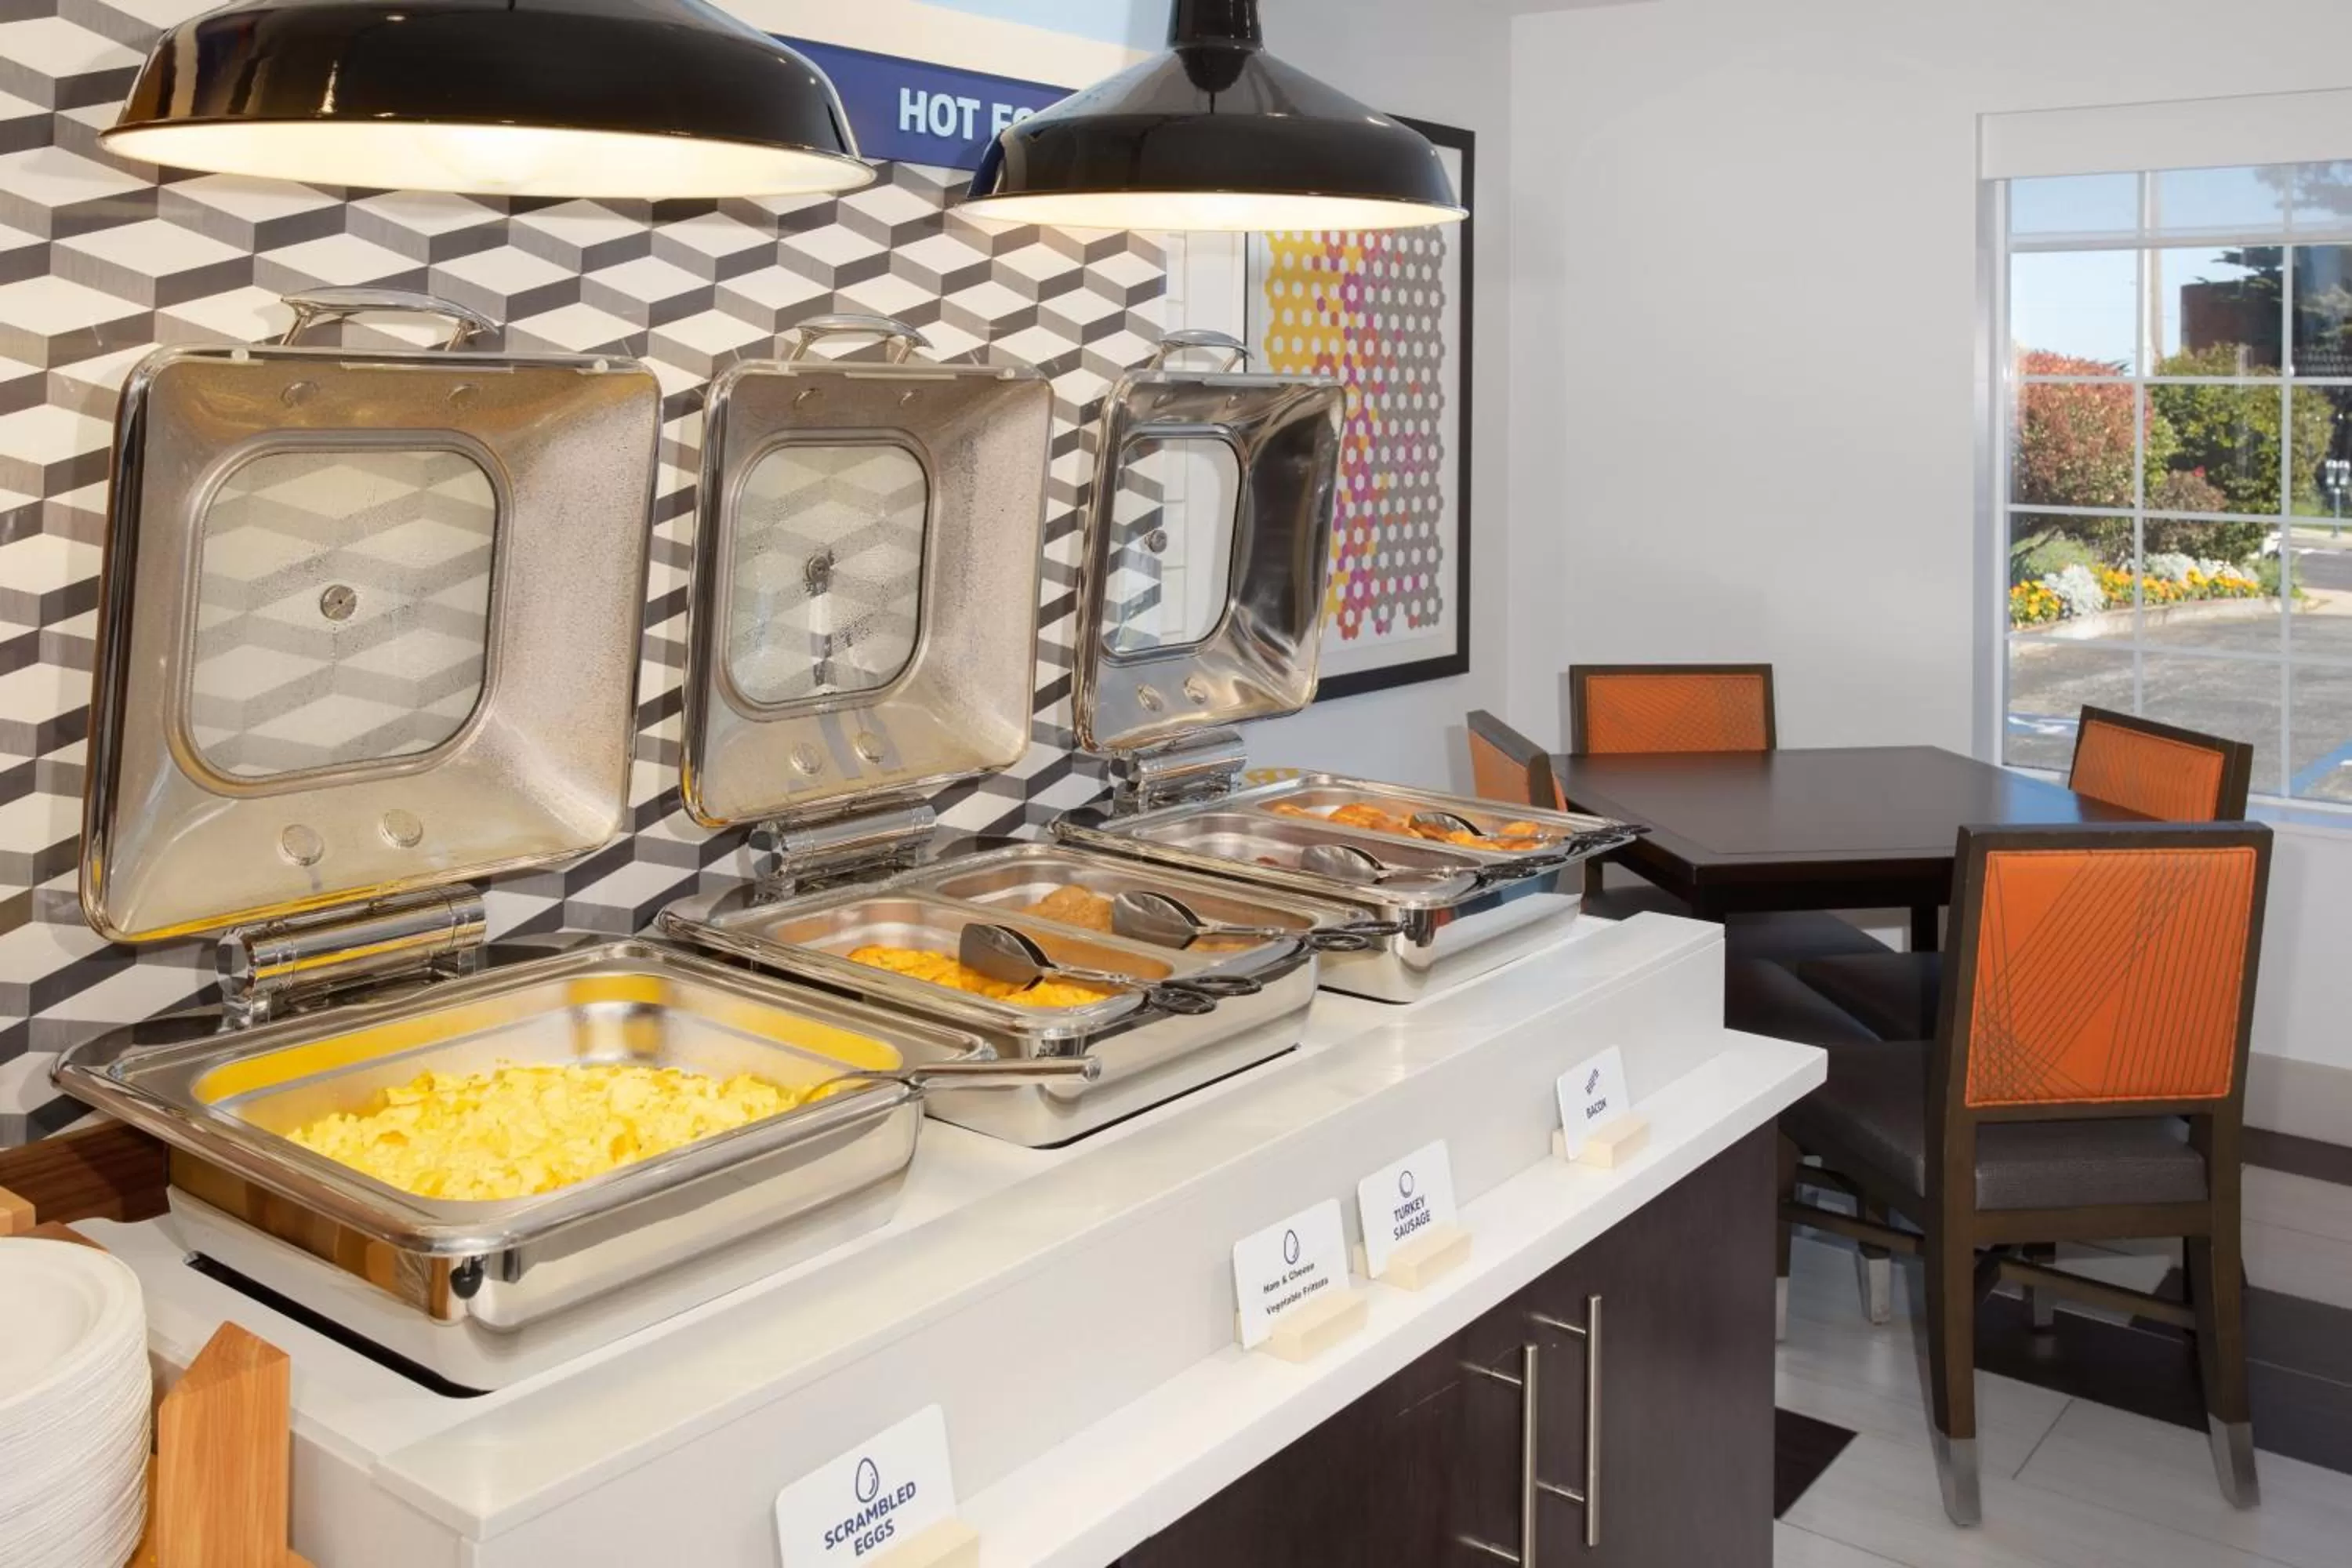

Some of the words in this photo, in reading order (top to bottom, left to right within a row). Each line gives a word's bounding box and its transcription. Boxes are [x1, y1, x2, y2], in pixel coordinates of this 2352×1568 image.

[899, 87, 980, 140] HOT
[991, 103, 1035, 138] F
[1586, 1097, 1606, 1119] BACON
[1393, 1195, 1425, 1221] TURKEY
[1393, 1210, 1431, 1240] SAUSAGE
[1263, 1280, 1280, 1294] Ham
[1282, 1275, 1287, 1284] &
[1288, 1263, 1315, 1280] Cheese
[1266, 1291, 1301, 1315] Vegetable
[824, 1481, 916, 1551] SCRAMBLED
[854, 1519, 895, 1556] EGGS
